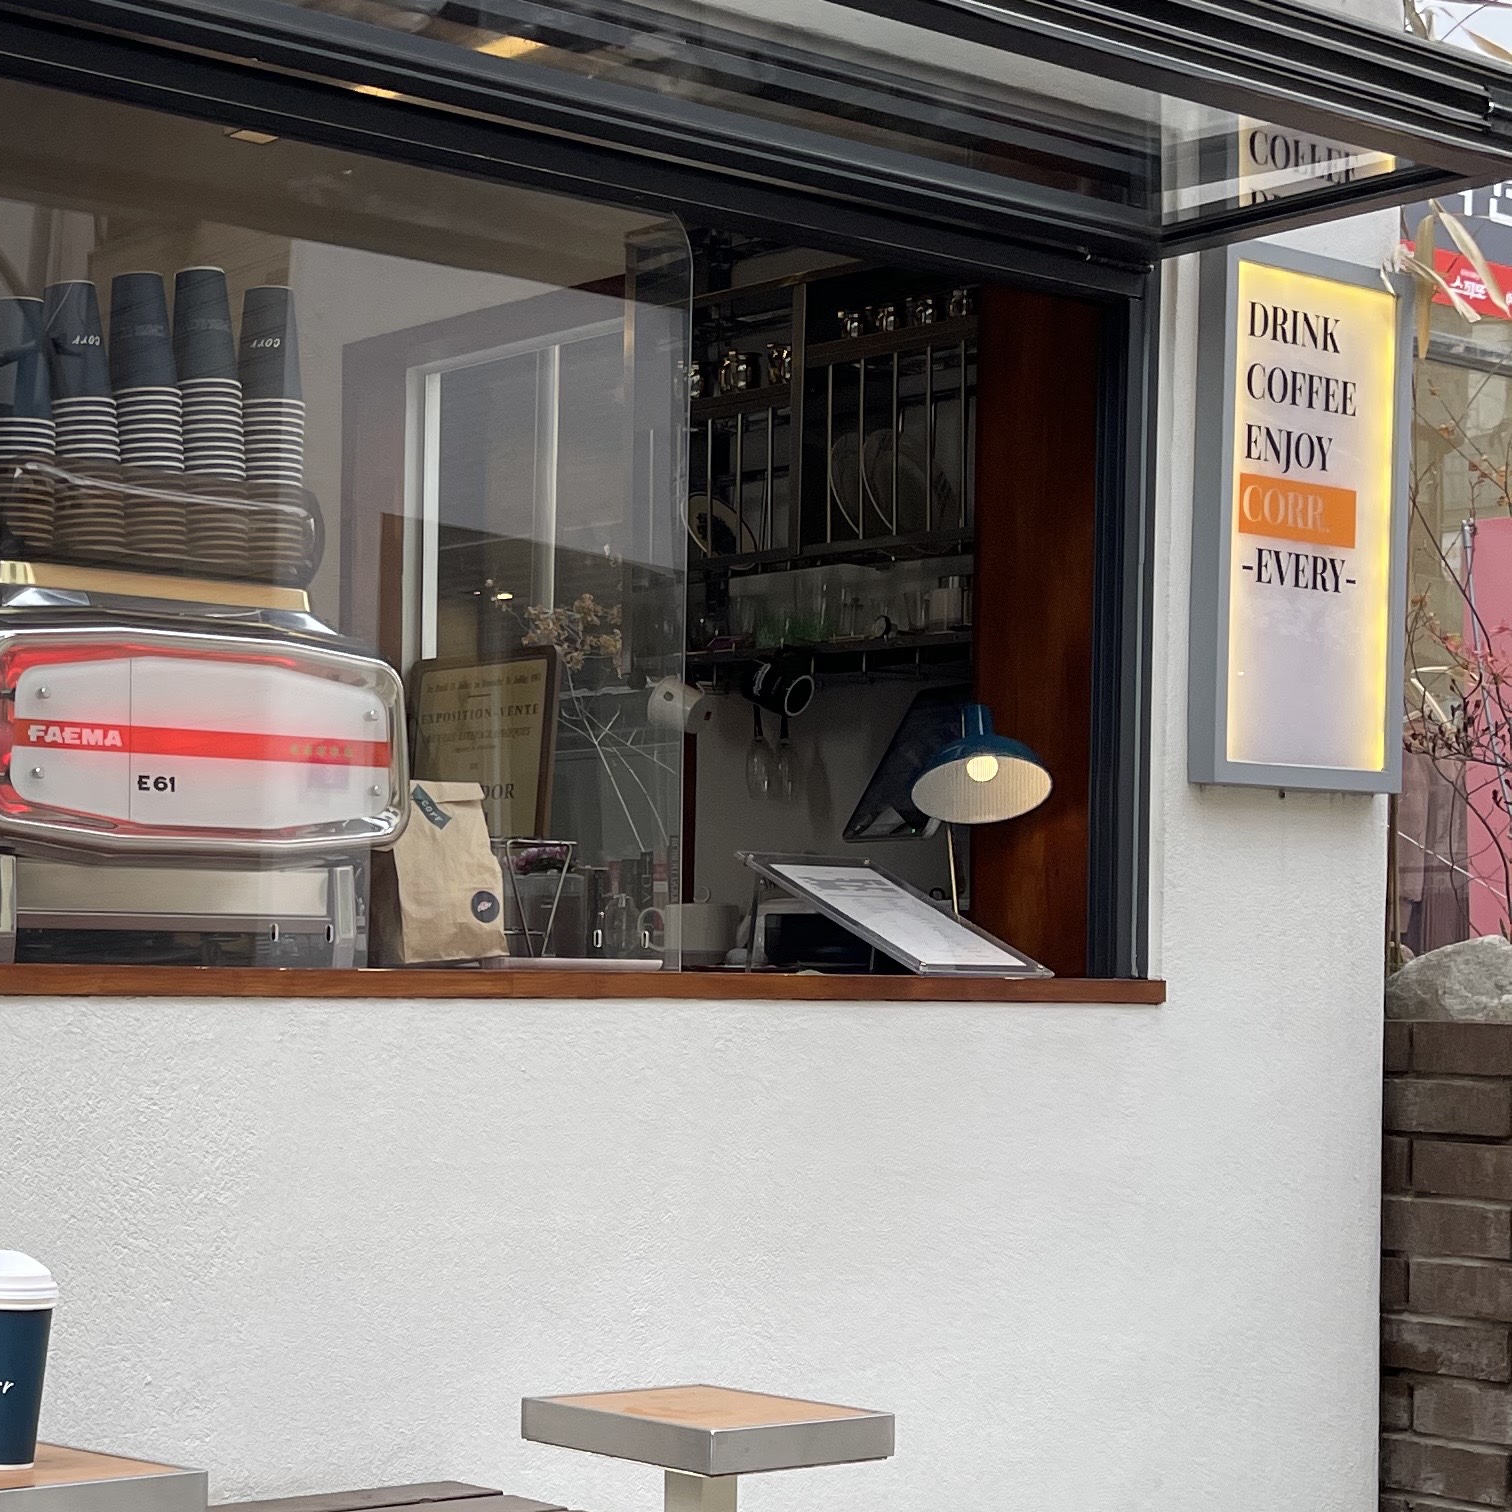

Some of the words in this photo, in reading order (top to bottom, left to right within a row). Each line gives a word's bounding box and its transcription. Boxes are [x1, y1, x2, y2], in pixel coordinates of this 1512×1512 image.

[1248, 301, 1341, 354] DRINK
[1247, 363, 1357, 417] COFFEE
[1245, 423, 1333, 474] ENJOY
[28, 725, 123, 748] FAEMA
[420, 799, 445, 822] corr
